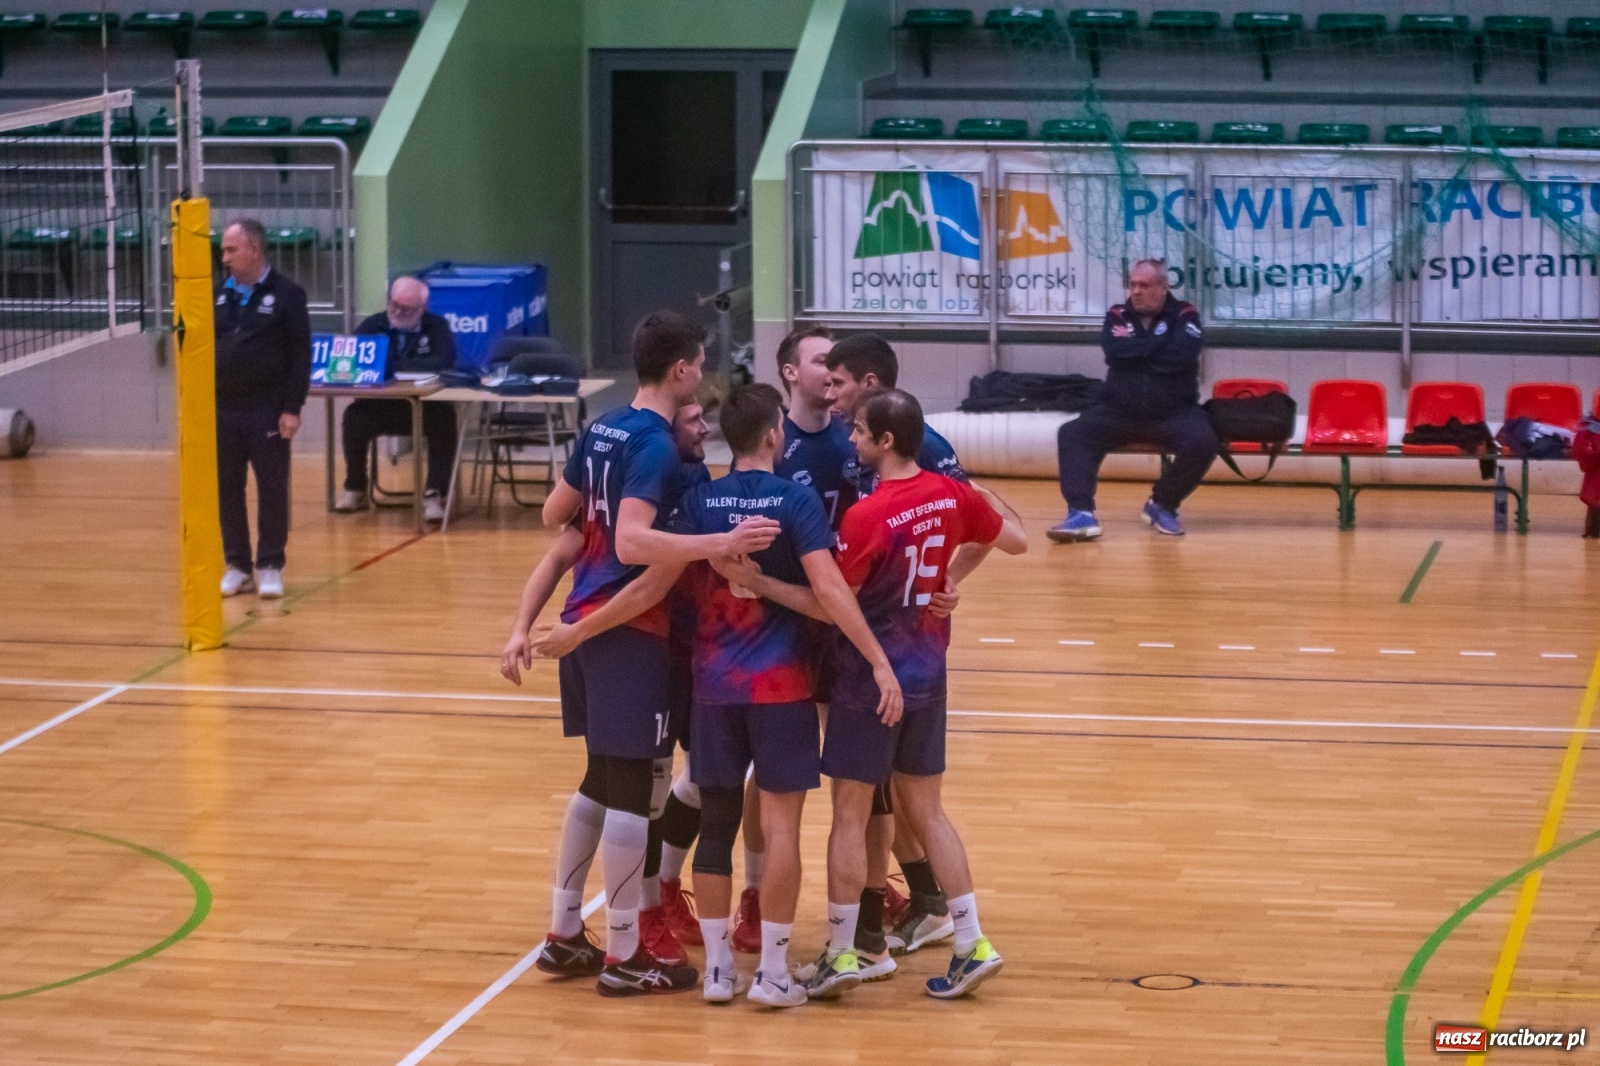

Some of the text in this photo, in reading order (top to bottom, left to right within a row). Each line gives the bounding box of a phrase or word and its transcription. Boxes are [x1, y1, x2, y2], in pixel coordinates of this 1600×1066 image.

[1124, 176, 1600, 232] POWIAT RACIB
[852, 266, 1077, 294] powiat racborski
[1121, 255, 1363, 296] bicujemy,
[313, 341, 329, 364] 11
[358, 341, 376, 364] 13
[586, 456, 611, 527] 14
[705, 496, 737, 508] TALENT
[886, 508, 916, 529] TALENT
[902, 534, 945, 608] 15
